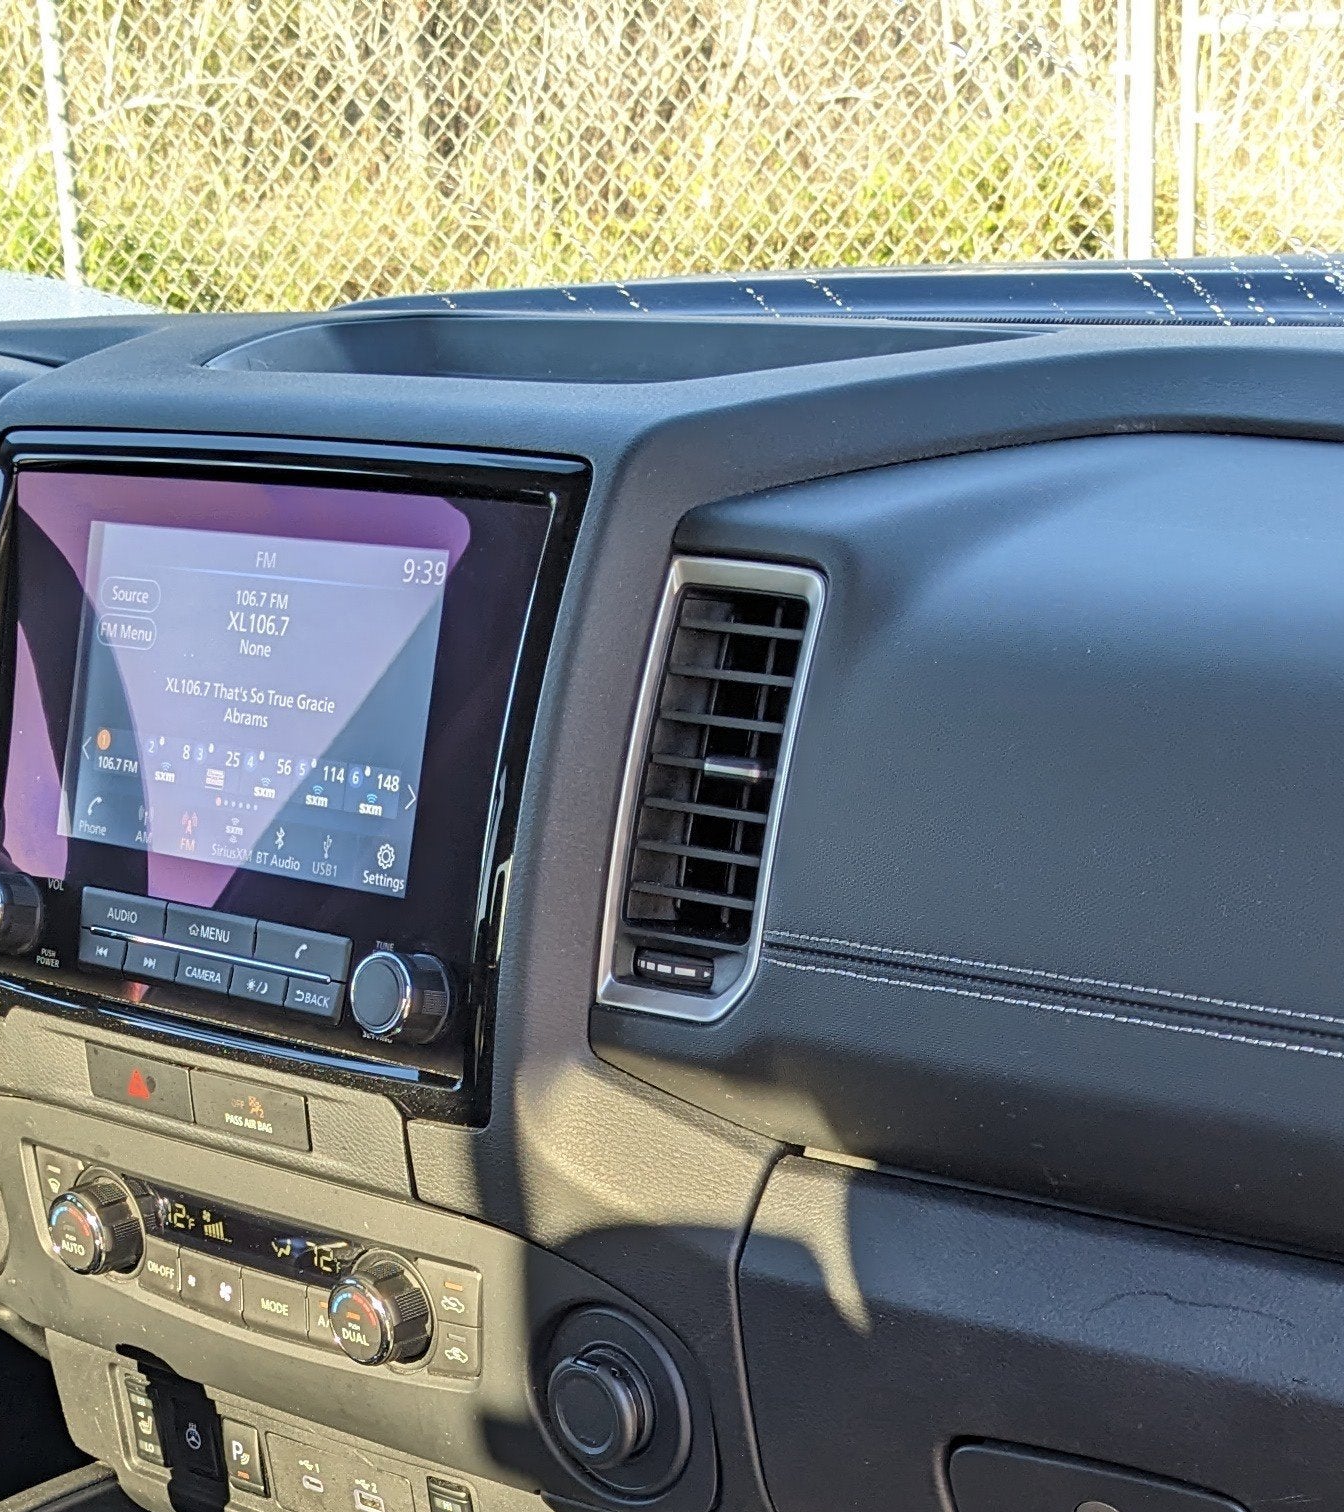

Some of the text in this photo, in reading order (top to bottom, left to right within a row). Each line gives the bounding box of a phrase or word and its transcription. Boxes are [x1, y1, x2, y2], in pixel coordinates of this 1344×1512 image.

[256, 551, 276, 568] FM
[402, 558, 447, 586] 9:39
[112, 586, 149, 604] Source
[235, 590, 289, 609] 106.7 FM
[100, 622, 152, 642] FM Menu
[227, 611, 290, 636] XL106.7
[239, 639, 272, 657] None
[165, 677, 335, 714] XL106.7 That's So True Gracie
[223, 708, 269, 728] Abrams
[148, 741, 154, 753] 2
[182, 745, 191, 760] 8
[98, 756, 138, 774] 106.7 FM
[225, 751, 240, 767] 25
[247, 756, 254, 768] 4
[277, 759, 292, 776] 56
[155, 771, 175, 783] sxm
[299, 763, 306, 776] 5
[323, 766, 345, 784] 114
[352, 771, 359, 784] 6
[377, 774, 400, 792] 148
[254, 786, 275, 798] sxm
[305, 794, 328, 808] sxm
[359, 803, 383, 816] sxm
[78, 819, 107, 836] Phone
[180, 838, 196, 851] FM
[211, 843, 252, 863] SiriusXM
[256, 851, 301, 871] BT Audio
[312, 861, 338, 877] USB1
[47, 878, 64, 891] VOL
[363, 870, 404, 893] Settings
[107, 907, 138, 924] AUDIO
[200, 925, 230, 943] MENU
[36, 955, 59, 968] POWER
[185, 966, 222, 984] CAMERA
[305, 993, 330, 1009] BACK
[224, 1112, 244, 1127] PASS
[257, 1121, 273, 1134] BAG
[61, 1240, 85, 1256] AUTO
[260, 1297, 289, 1316] MODE
[341, 1327, 370, 1347] DUAL
